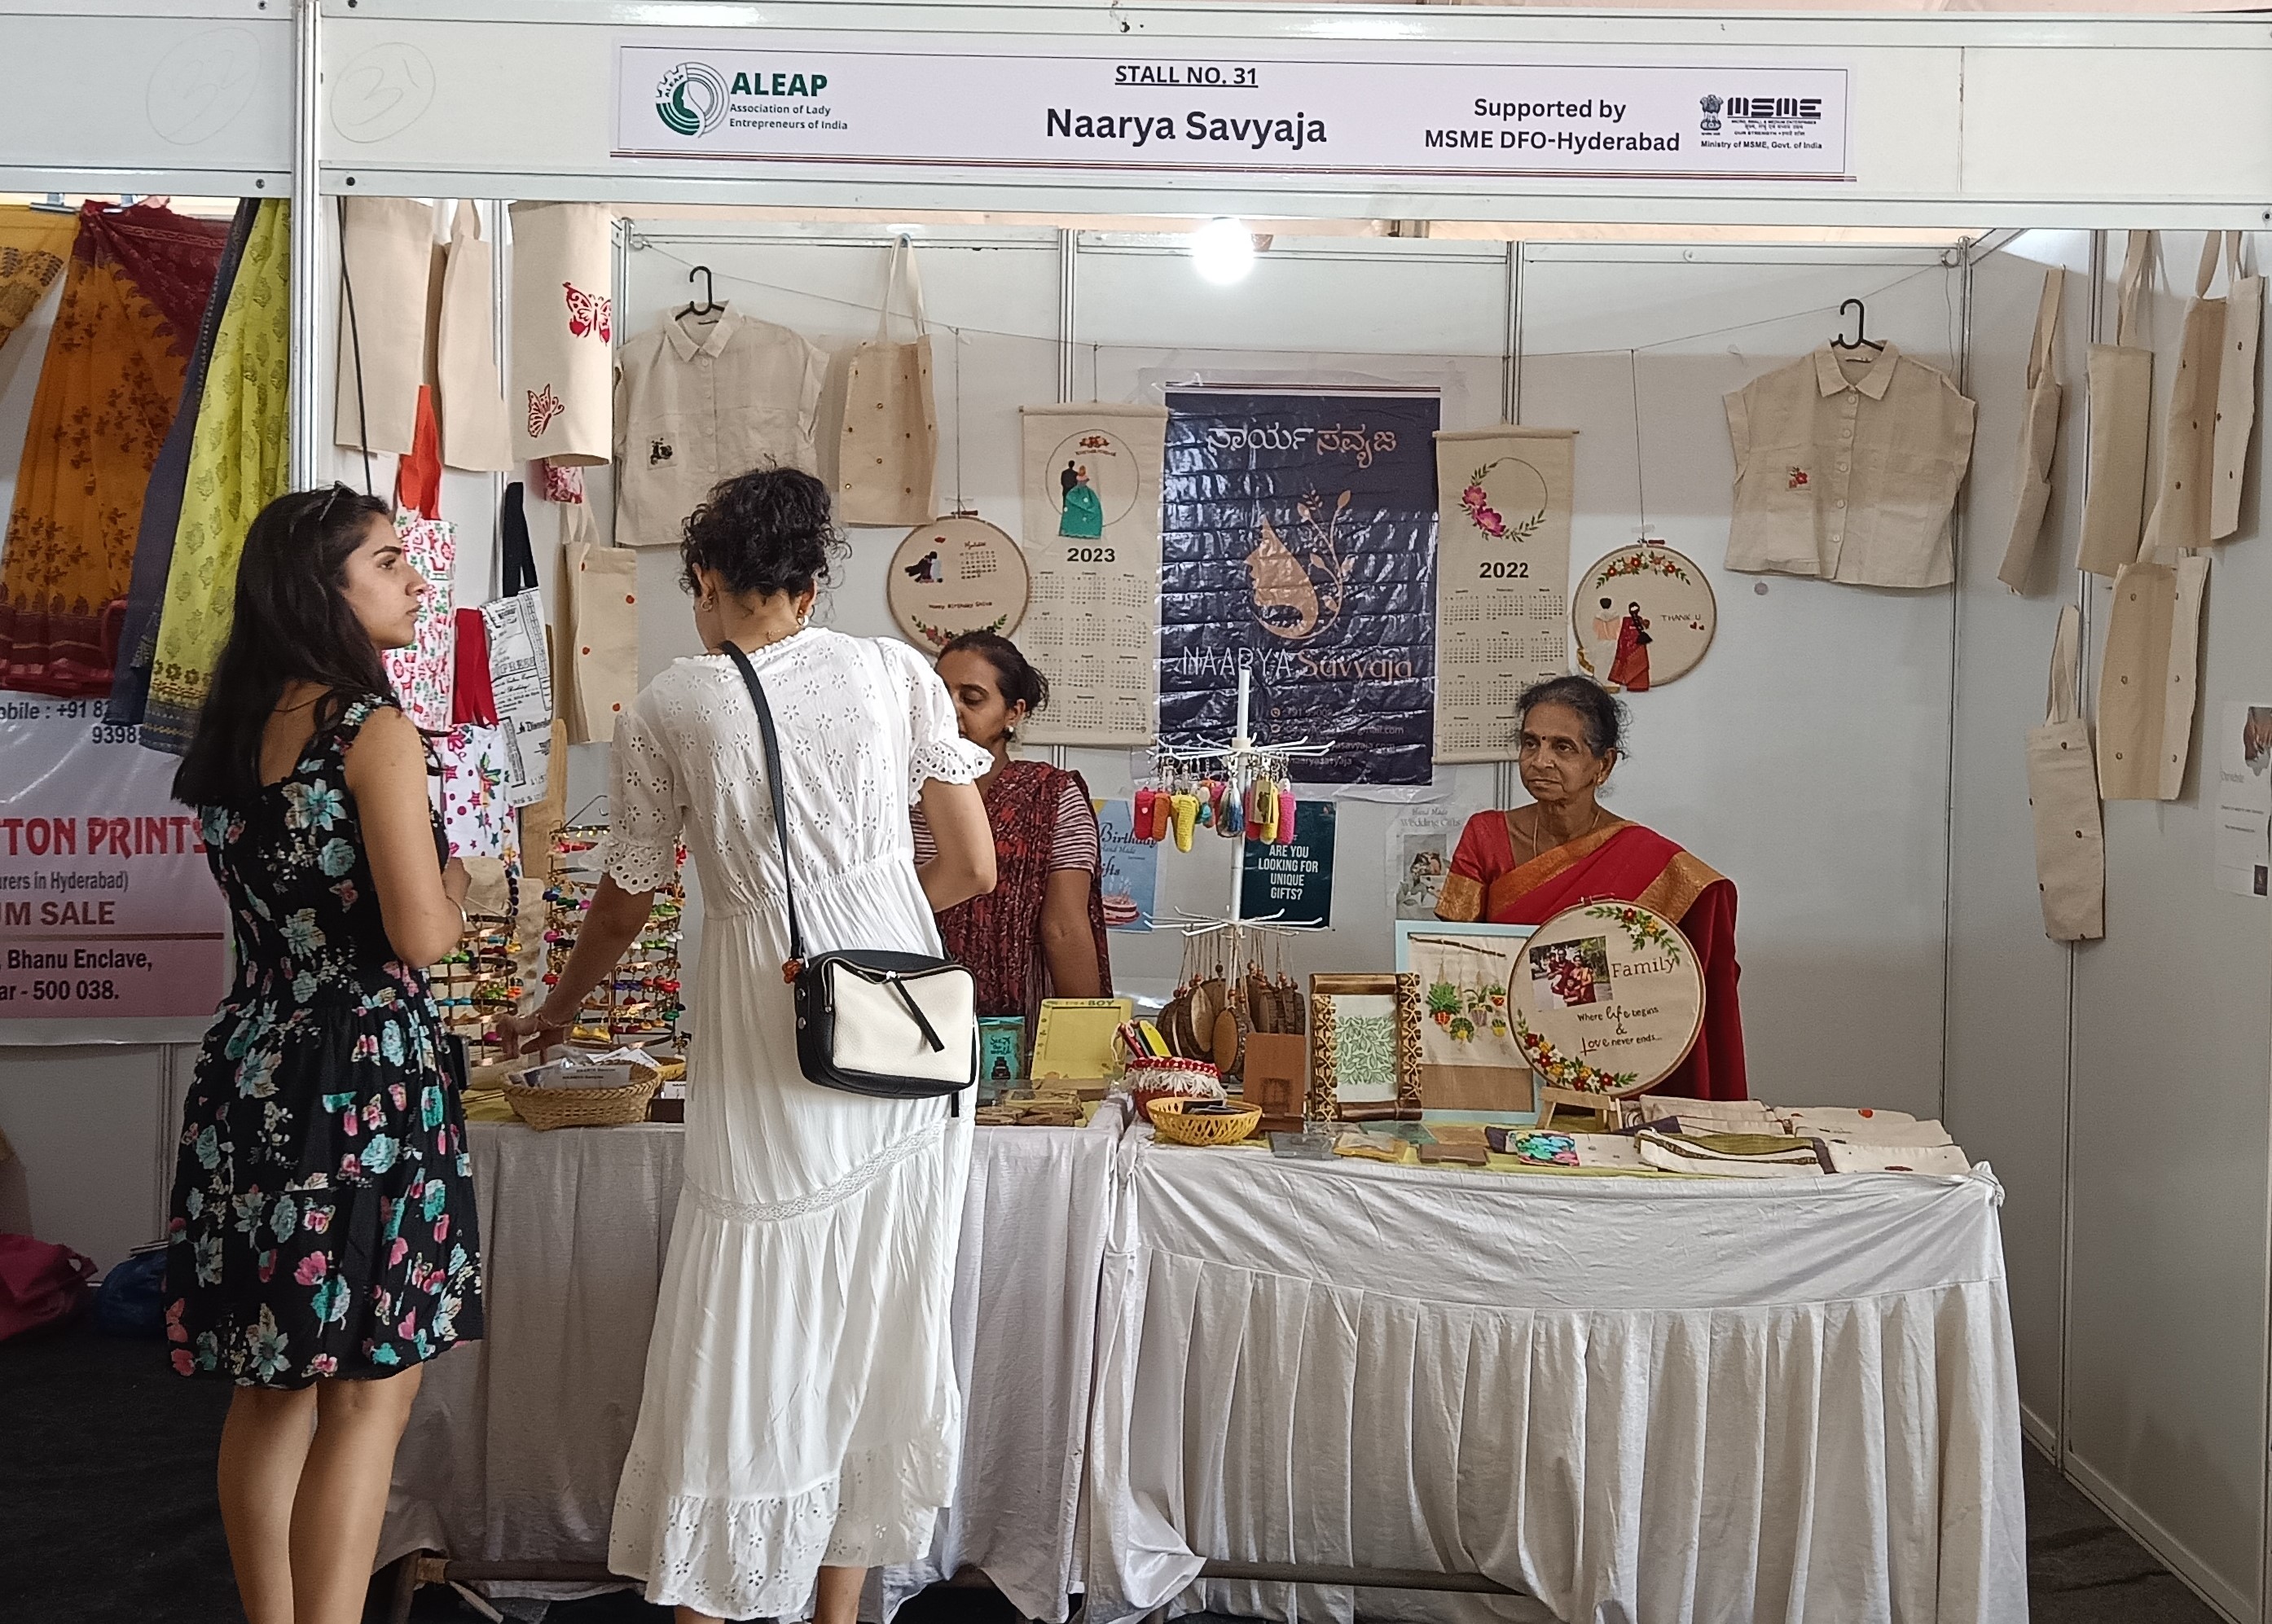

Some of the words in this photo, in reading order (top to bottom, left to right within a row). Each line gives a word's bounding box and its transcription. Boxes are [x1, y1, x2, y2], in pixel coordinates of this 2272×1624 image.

[730, 72, 828, 97] ALEAP
[1115, 65, 1180, 85] STALL
[1185, 67, 1227, 86] NO.
[1233, 67, 1258, 86] 31
[730, 103, 789, 116] Association
[793, 105, 803, 114] of
[806, 106, 831, 117] Lady
[1474, 97, 1593, 121] Supported
[1598, 99, 1627, 124] by
[1727, 97, 1822, 117] MSME
[730, 118, 805, 132] Entrepreneurs
[807, 120, 819, 129] of
[820, 121, 848, 130] India
[1048, 108, 1176, 147] Naarya
[1185, 111, 1327, 150] Savyaja
[1425, 129, 1493, 148] MSME
[1501, 130, 1680, 155] DFO-Hyderabad
[1701, 141, 1731, 150] Ministry
[1743, 141, 1769, 150] MSME,
[1066, 547, 1115, 563] 2023
[1479, 561, 1529, 579] 2022
[1660, 613, 1690, 622] THANK
[1182, 647, 1292, 677] NAARYA
[1297, 648, 1413, 683] Savyaja
[56, 700, 87, 719] +91
[93, 700, 109, 718] 8
[92, 726, 140, 744] 9398
[0, 817, 76, 856] TON
[1269, 845, 1288, 857] ARE
[1290, 845, 1309, 858] YOU
[1258, 858, 1299, 872] LOOKING
[1300, 860, 1319, 873] FOR
[34, 871, 47, 890] in
[51, 871, 129, 893] Hyderabad)
[1270, 872, 1305, 886] UNIQUE
[1270, 886, 1303, 901] GIFTS?
[0, 902, 32, 926] M
[41, 901, 116, 926] SALE
[7, 949, 68, 969] Bhanu
[74, 948, 153, 972] Enclave,
[1611, 956, 1675, 978] Family
[33, 980, 71, 1001] 500
[77, 980, 120, 1000] 038.
[1606, 1005, 1631, 1022] life
[1632, 1007, 1659, 1017] begins
[1580, 1037, 1611, 1056] Love
[1611, 1038, 1634, 1047] never
